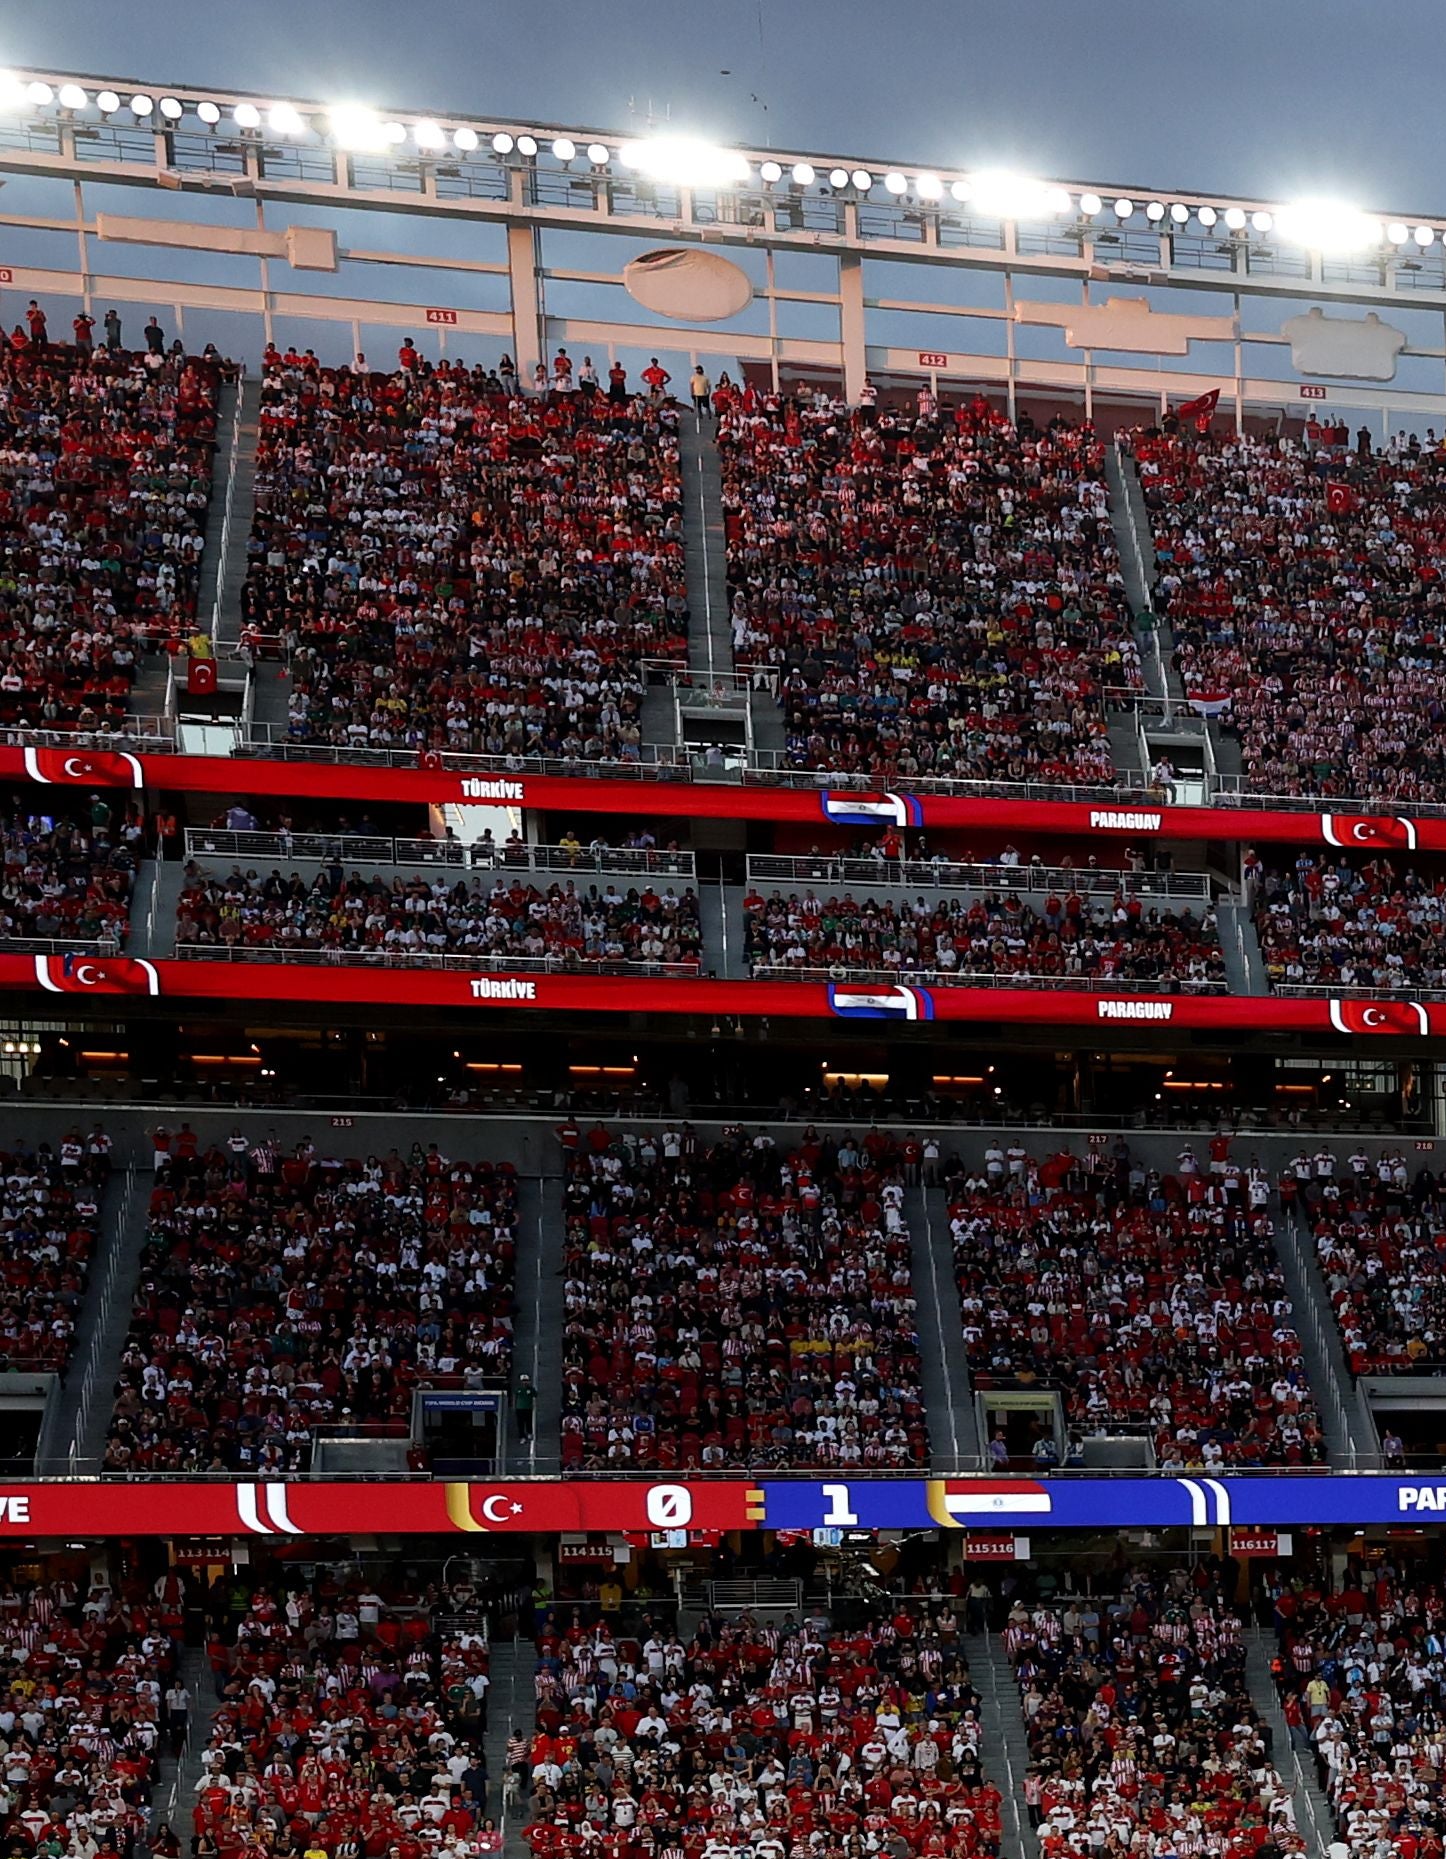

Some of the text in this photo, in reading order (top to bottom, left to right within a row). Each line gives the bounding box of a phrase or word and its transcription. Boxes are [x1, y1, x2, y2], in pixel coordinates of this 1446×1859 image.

[429, 312, 453, 322] 411
[921, 355, 944, 365] 412
[1302, 388, 1323, 397] 413
[461, 778, 523, 799] TÜRKİYE
[1091, 812, 1160, 830] PARAGUAY
[471, 978, 535, 999] TÜRKİYE
[1099, 1001, 1171, 1019] PARAGUAY
[647, 1485, 692, 1527] 0
[820, 1485, 858, 1525] 1
[564, 1546, 613, 1556] 114 115
[967, 1544, 1014, 1554] 115 116
[1232, 1540, 1276, 1550] 116 117
